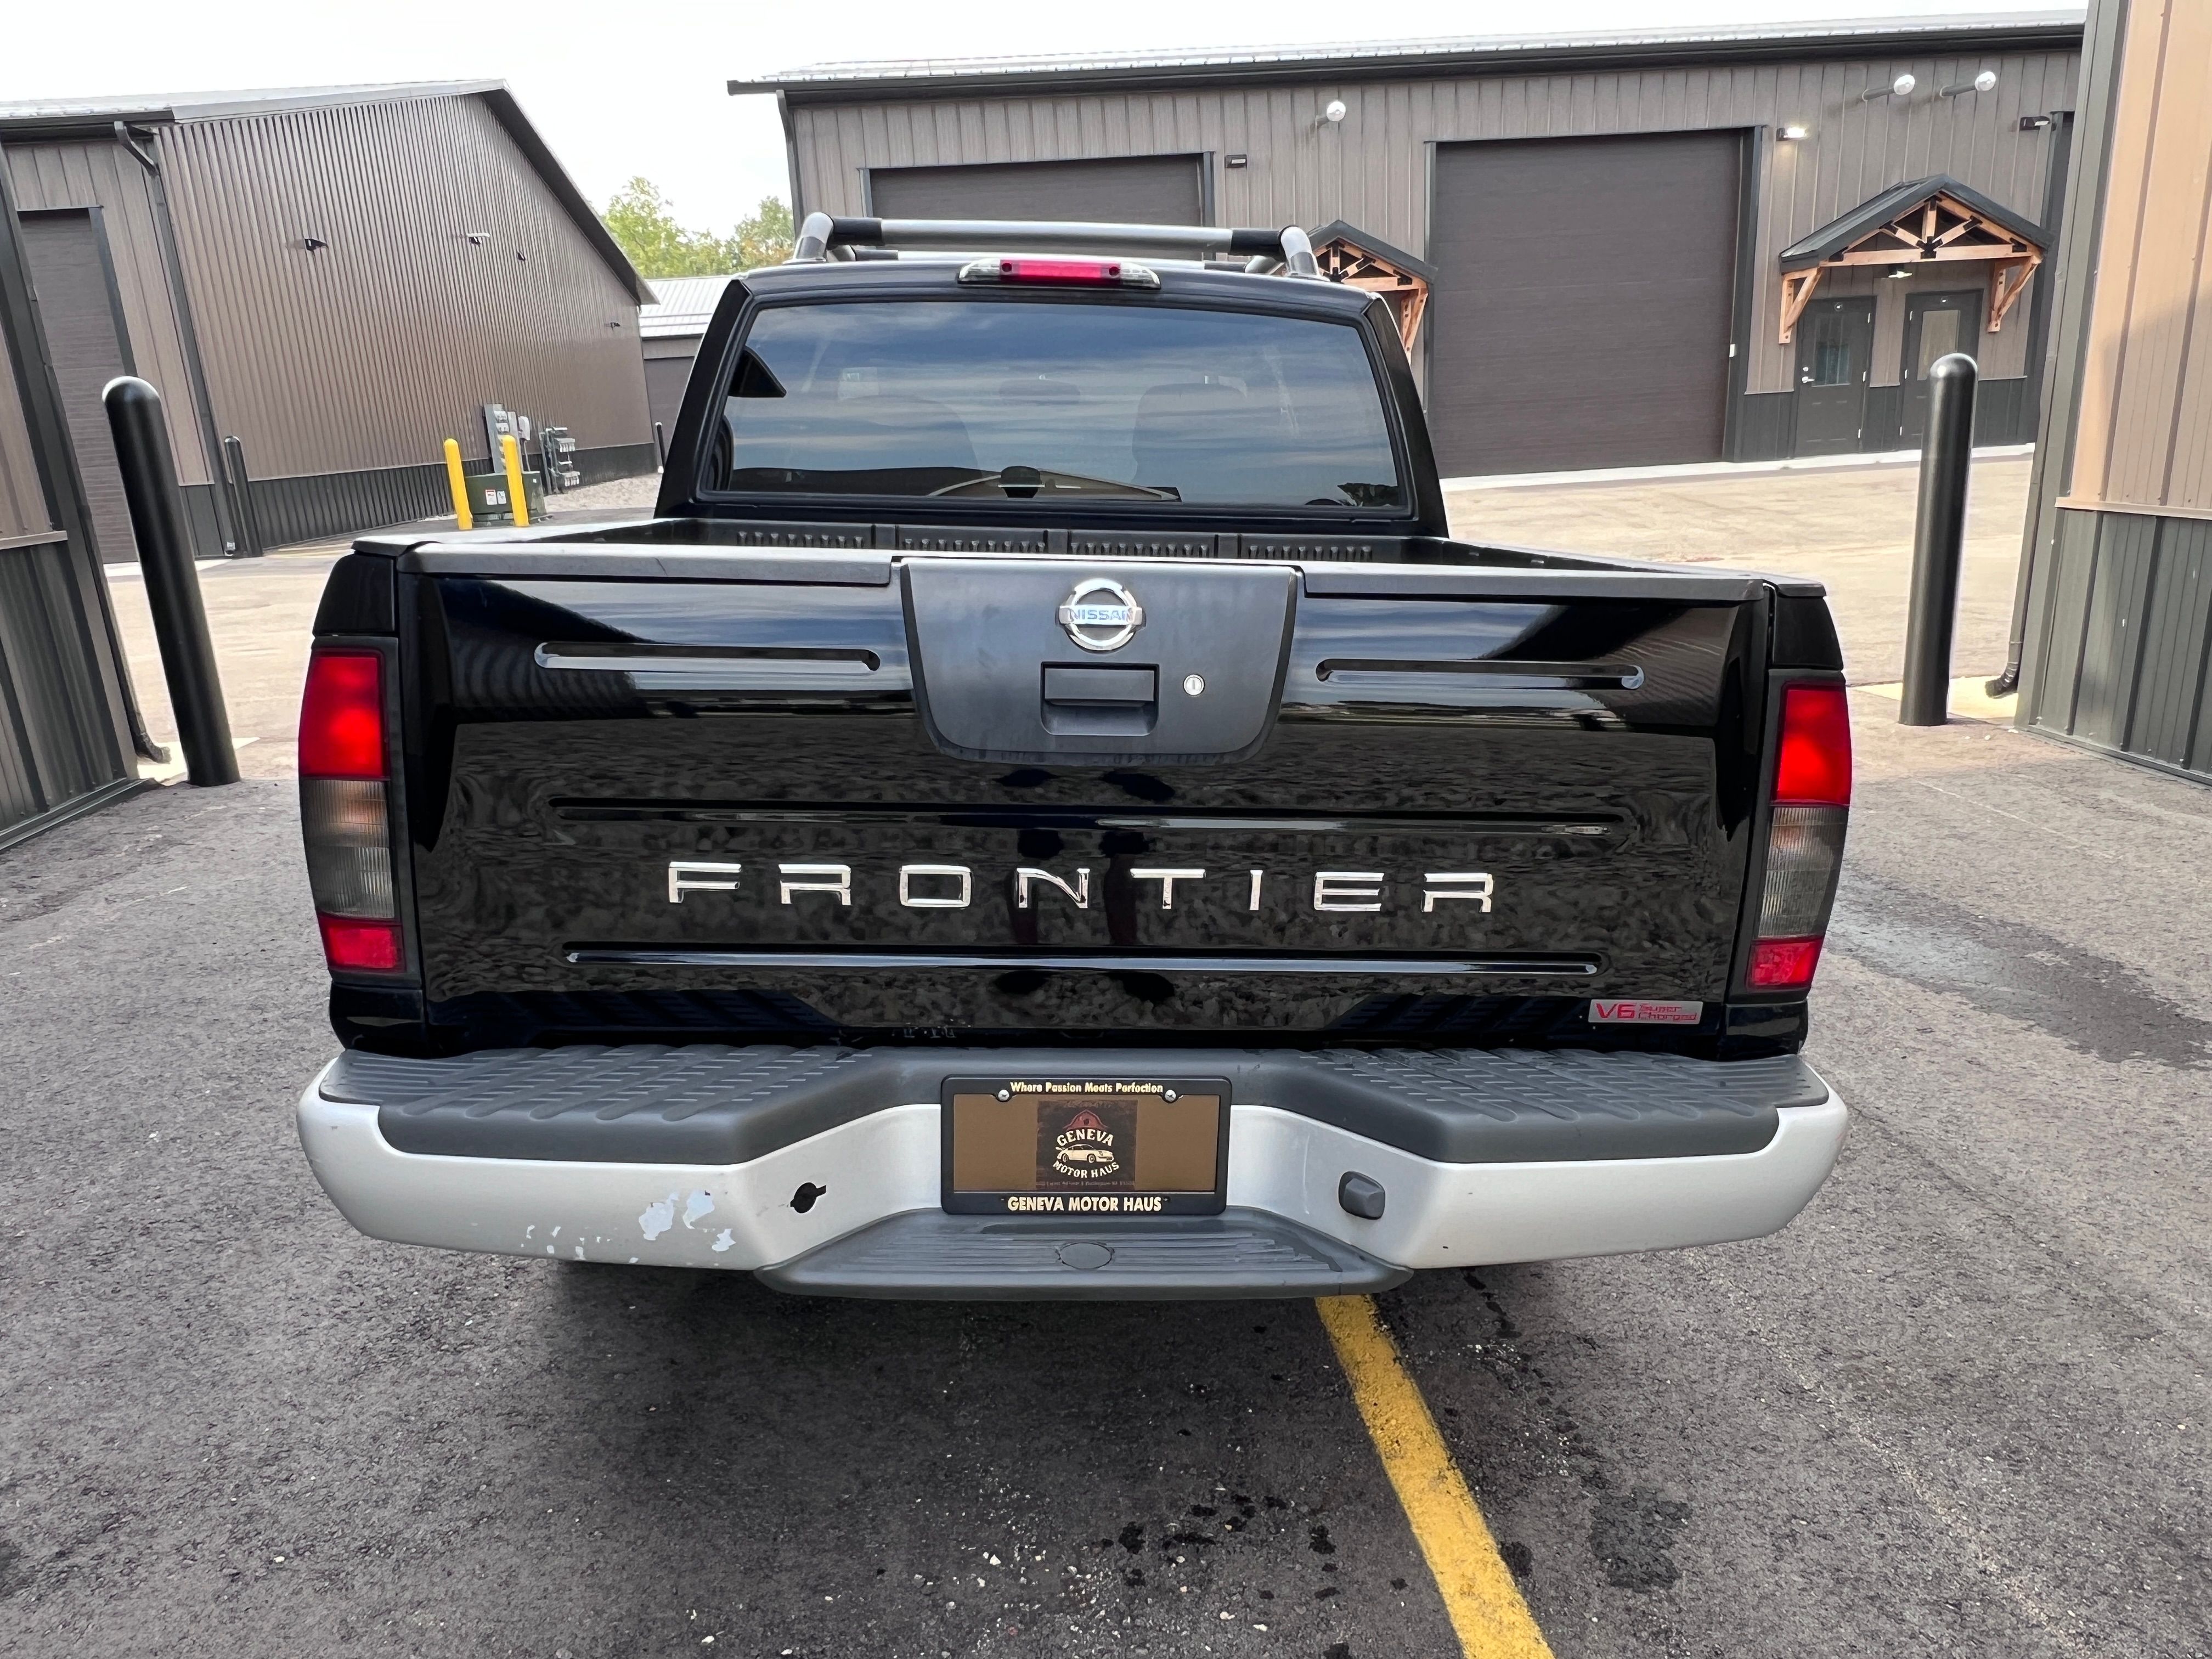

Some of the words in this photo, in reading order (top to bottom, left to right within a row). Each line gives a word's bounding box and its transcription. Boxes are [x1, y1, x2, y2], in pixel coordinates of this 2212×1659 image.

[1070, 609, 1132, 620] NISSAN
[669, 861, 1494, 913] FRONTIER
[1596, 1003, 1636, 1019] V6
[1010, 1082, 1042, 1092] Where
[1045, 1082, 1081, 1092] Passion
[1085, 1082, 1113, 1092] Meets
[1116, 1082, 1163, 1093] Perfection
[1057, 1128, 1114, 1146] GENEVA
[1052, 1160, 1088, 1178] MOTOR
[1091, 1161, 1119, 1178] HAUS
[1007, 1197, 1064, 1211] GENEVA
[1068, 1197, 1119, 1211] MOTOR
[1124, 1197, 1161, 1211] HAUS
